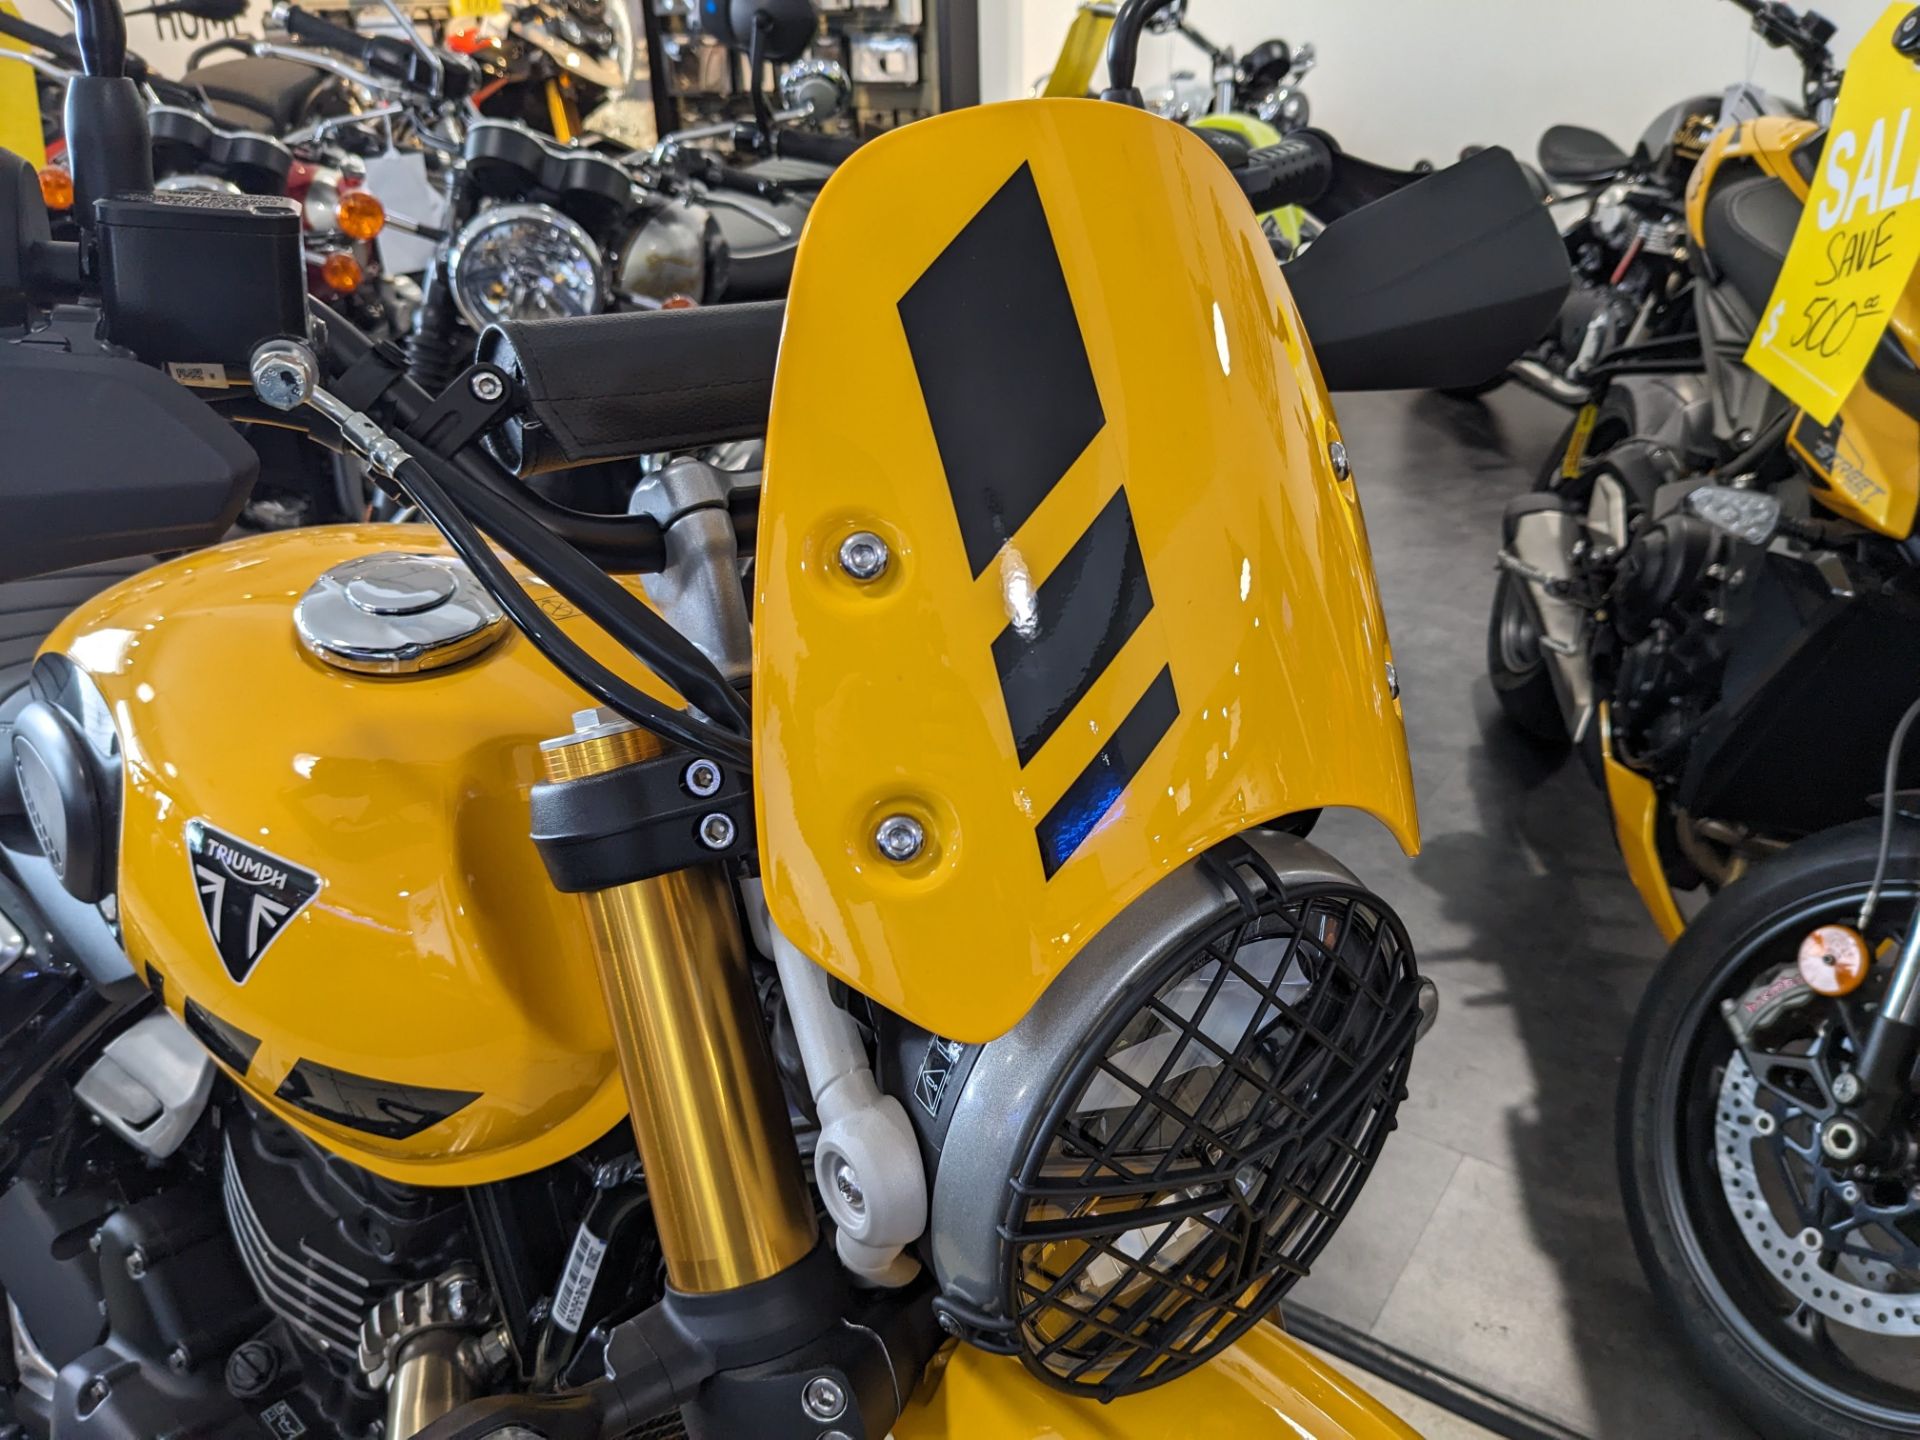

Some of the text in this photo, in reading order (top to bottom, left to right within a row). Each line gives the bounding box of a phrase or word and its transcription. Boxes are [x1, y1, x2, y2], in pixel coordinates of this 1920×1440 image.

[1814, 211, 1896, 286] SAVE
[1760, 300, 1786, 348] $
[207, 838, 288, 890] TRIUMPH
